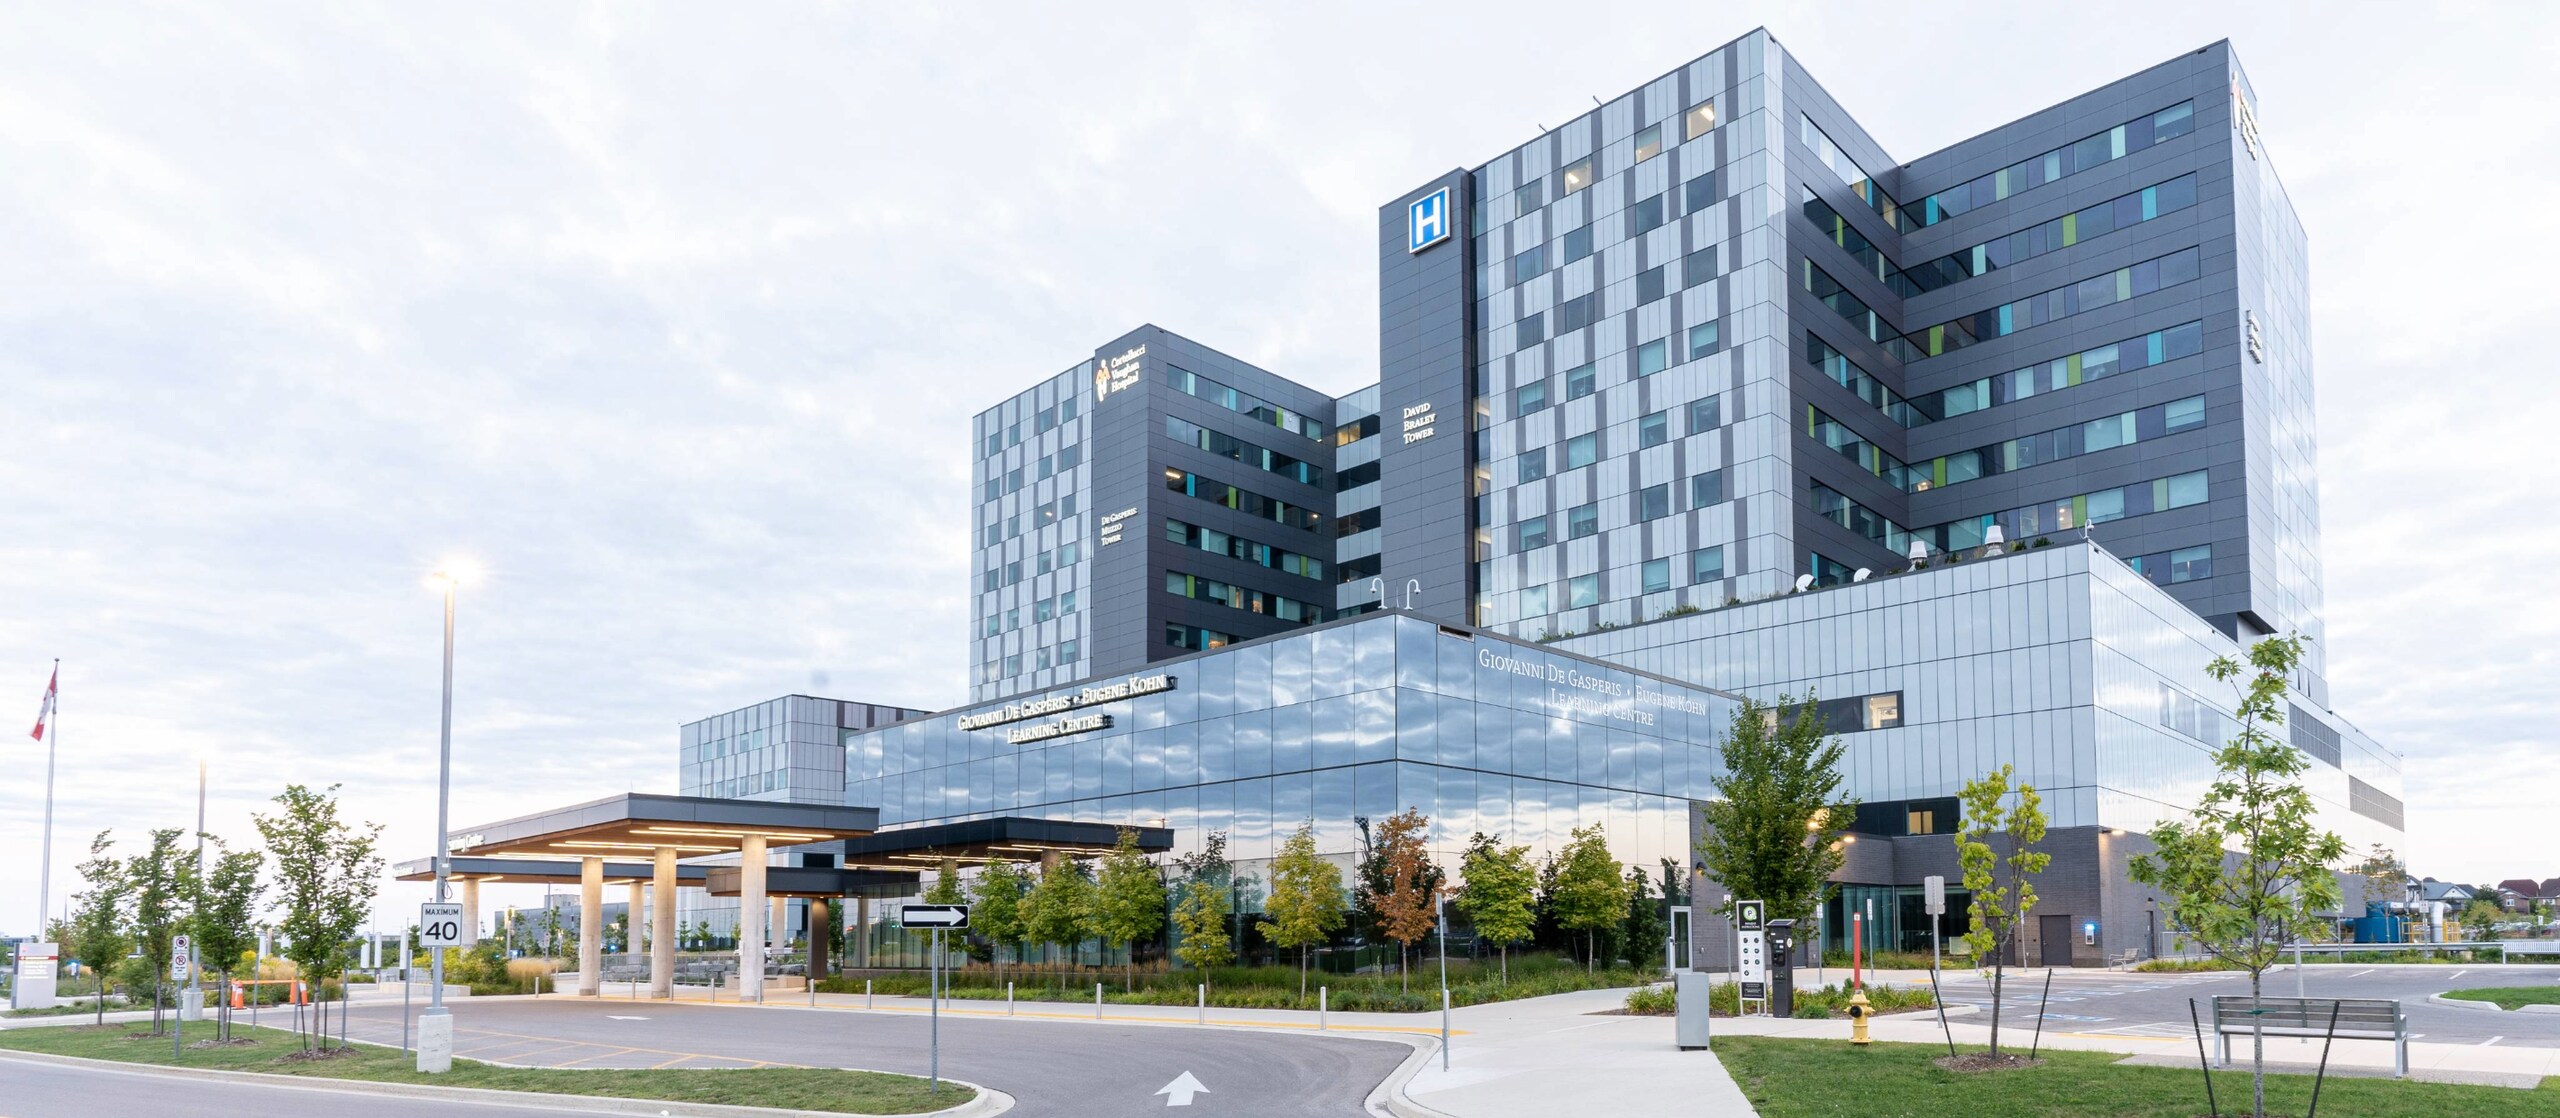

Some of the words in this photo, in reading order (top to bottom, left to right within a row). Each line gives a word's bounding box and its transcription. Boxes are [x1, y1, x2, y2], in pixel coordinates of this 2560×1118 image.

[1415, 195, 1441, 245] H
[1403, 402, 1431, 419] DAVID
[1403, 413, 1437, 432] BRALEY
[1402, 427, 1435, 445] TOWER
[1478, 648, 1545, 680] GIOVANNI
[1547, 663, 1566, 684] DE
[1568, 669, 1622, 697] GASPERIS
[1635, 684, 1677, 710] EUGENE
[1677, 695, 1707, 717] KOHN
[957, 710, 1006, 730] GIOVANNI
[1005, 704, 1021, 721] DE
[1021, 695, 1071, 717] GASPERIS
[1081, 683, 1128, 705] EUGENE
[1128, 674, 1167, 695] KOHN
[1550, 688, 1610, 717] LEARNING
[1612, 703, 1655, 726] CENTRE
[1007, 722, 1059, 744] LEARNING
[1059, 713, 1104, 734] CENTRE
[425, 908, 459, 916] MAXIMUM
[425, 921, 458, 941] 40
